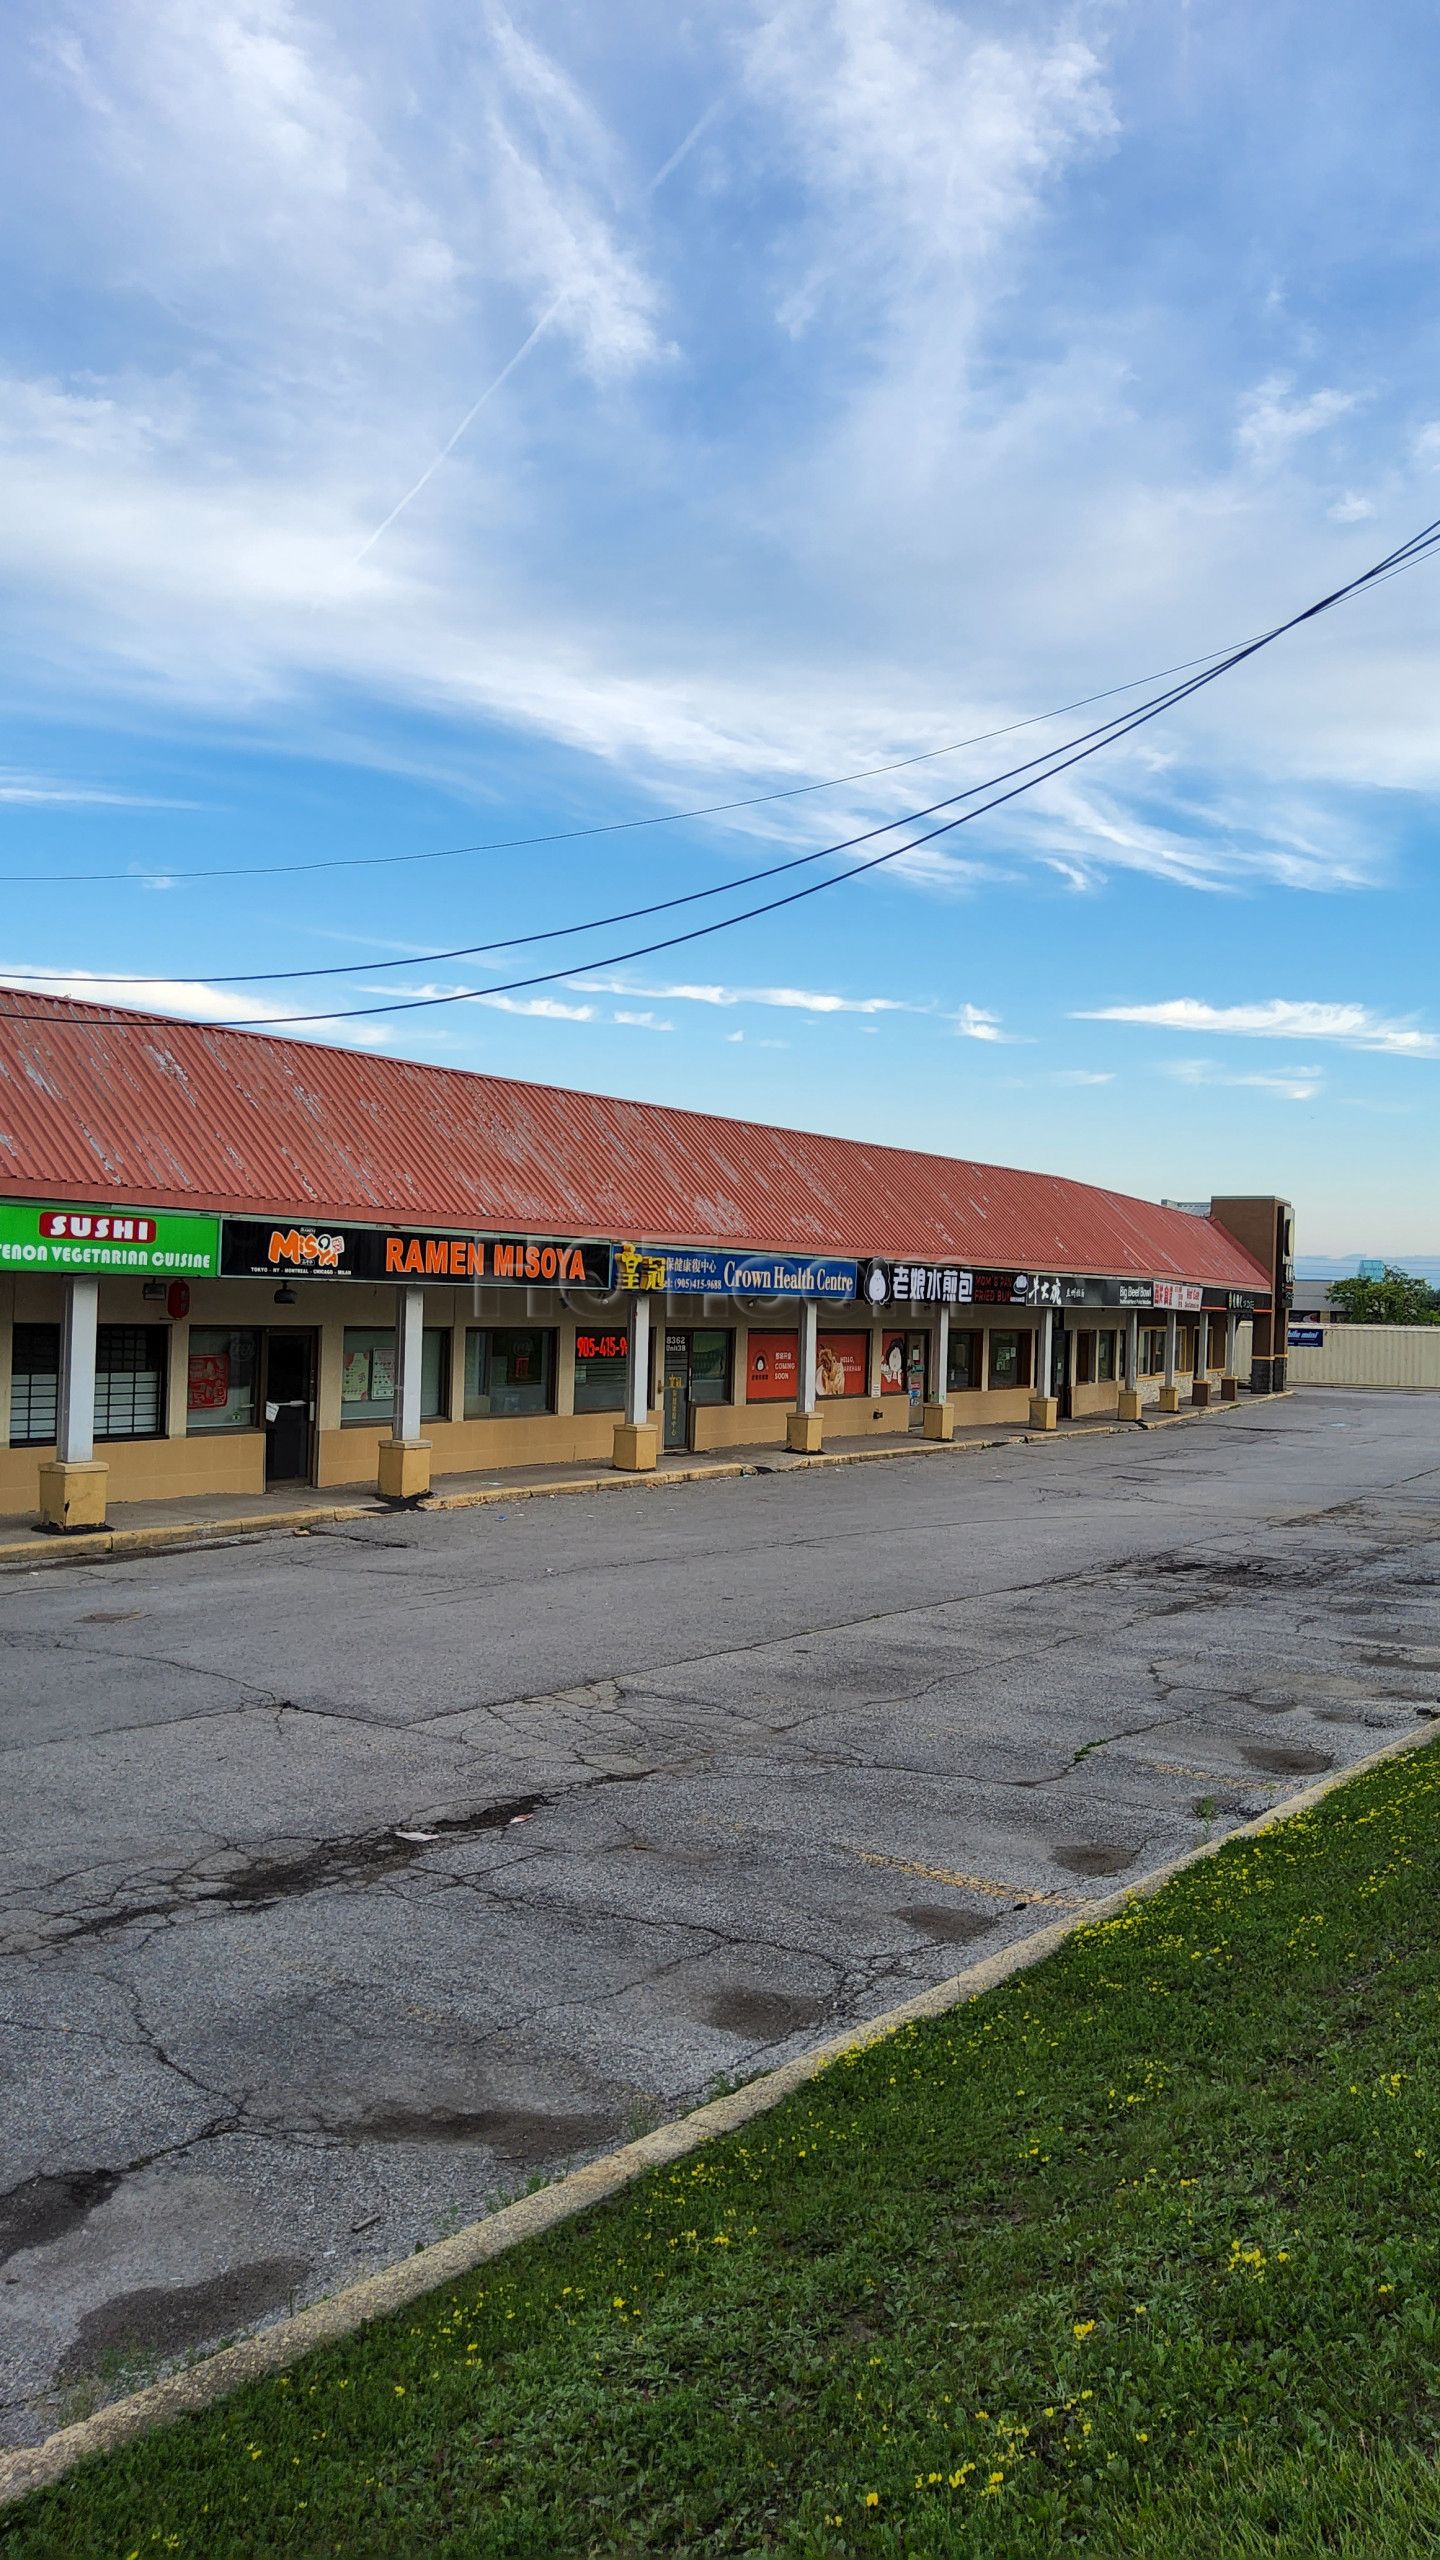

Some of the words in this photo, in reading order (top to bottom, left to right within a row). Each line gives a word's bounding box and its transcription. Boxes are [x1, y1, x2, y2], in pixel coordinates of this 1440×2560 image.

[50, 1216, 148, 1241] SUSHI
[0, 1243, 48, 1262] ENON
[52, 1246, 148, 1266] VEGETARIAN
[152, 1251, 210, 1269] CUISINE
[386, 1238, 485, 1276] RAMEN
[494, 1244, 586, 1281] MISOYA
[724, 1261, 771, 1289] Crown
[774, 1266, 815, 1291] Health
[817, 1268, 853, 1292] Centre
[892, 1266, 973, 1303] 老娘水煎包
[975, 1289, 995, 1301] FRIED
[1119, 1286, 1127, 1299] Big
[1128, 1286, 1139, 1297] Beef
[1139, 1286, 1151, 1298] Bowl
[666, 1336, 686, 1345] 8362
[775, 1362, 795, 1370] COMING
[775, 1372, 789, 1380] SOON
